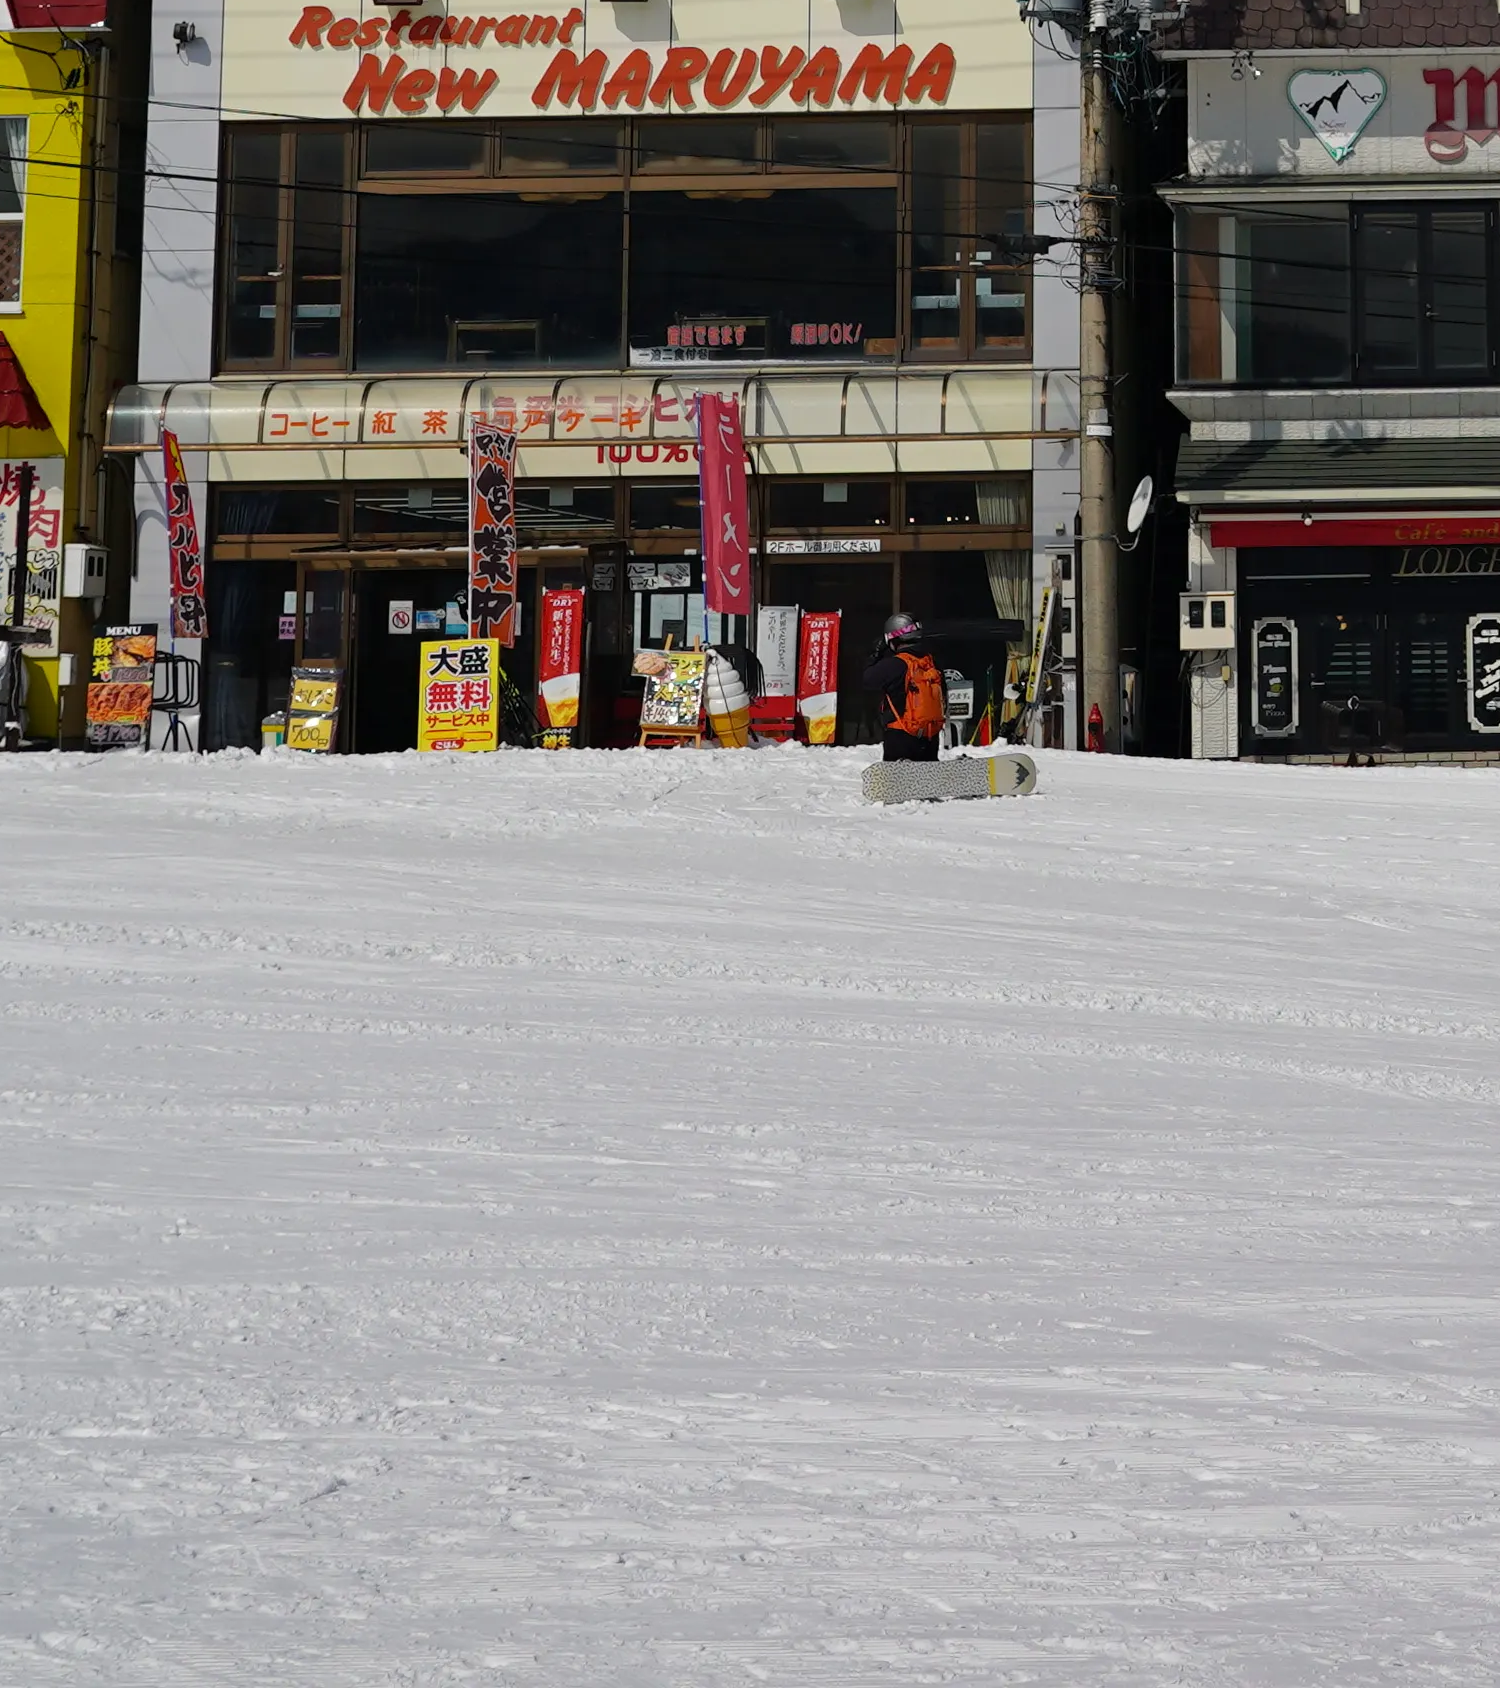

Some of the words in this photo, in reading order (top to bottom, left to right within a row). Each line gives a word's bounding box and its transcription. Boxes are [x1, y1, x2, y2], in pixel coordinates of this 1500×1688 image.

[289, 6, 585, 49] Restaurant
[342, 53, 498, 115] New
[531, 42, 956, 110] MARUYAMA
[269, 413, 351, 437] コーヒー
[717, 413, 744, 598] ラーメン
[1461, 522, 1500, 539] and
[472, 461, 517, 640] 営業中
[627, 565, 656, 575] ハニー
[631, 578, 658, 589] トースト
[105, 625, 142, 635] MENU
[428, 645, 489, 676] 大盛
[427, 679, 491, 712] 無料
[426, 713, 490, 728] サービス中
[292, 723, 329, 747] 700円
